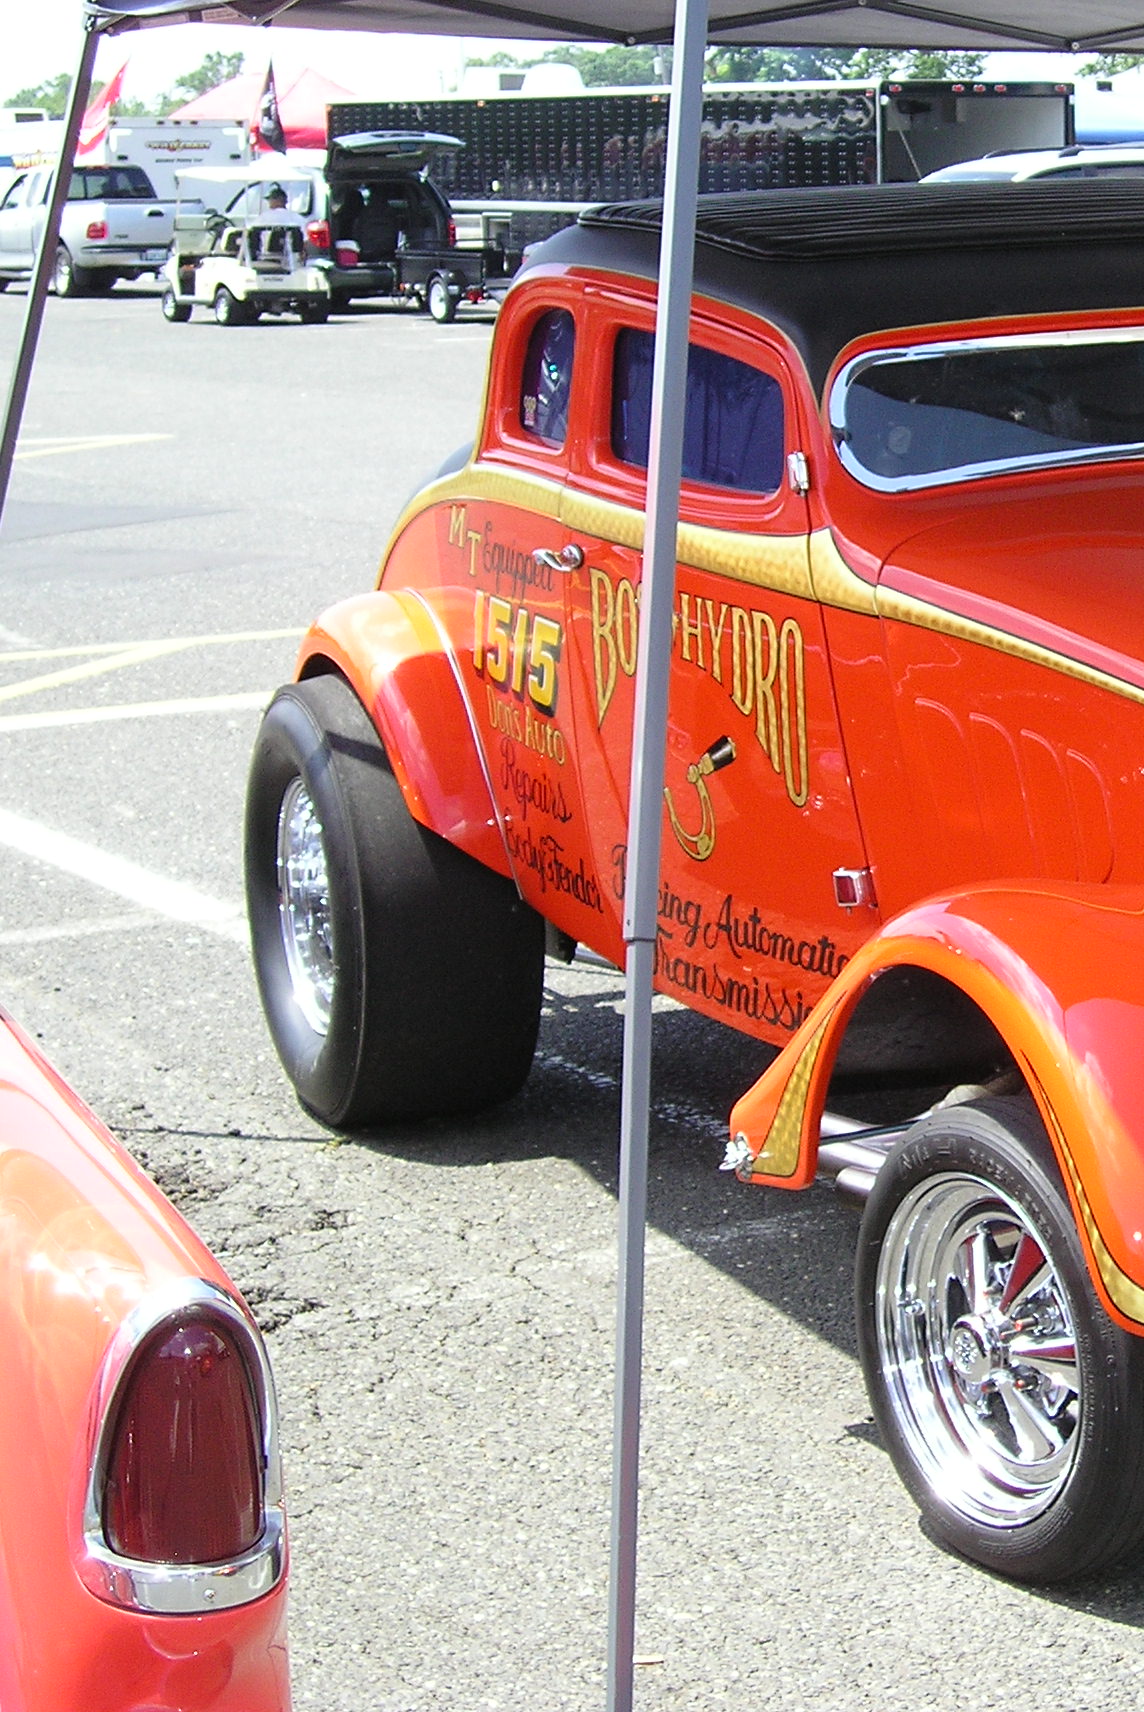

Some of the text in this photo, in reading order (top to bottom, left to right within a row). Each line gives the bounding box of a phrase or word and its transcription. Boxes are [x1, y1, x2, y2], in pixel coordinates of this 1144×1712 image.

[473, 589, 562, 716] 1515
[679, 592, 810, 808] HYDRO
[486, 684, 566, 765] Don's Auto
[499, 736, 572, 823] Repairs
